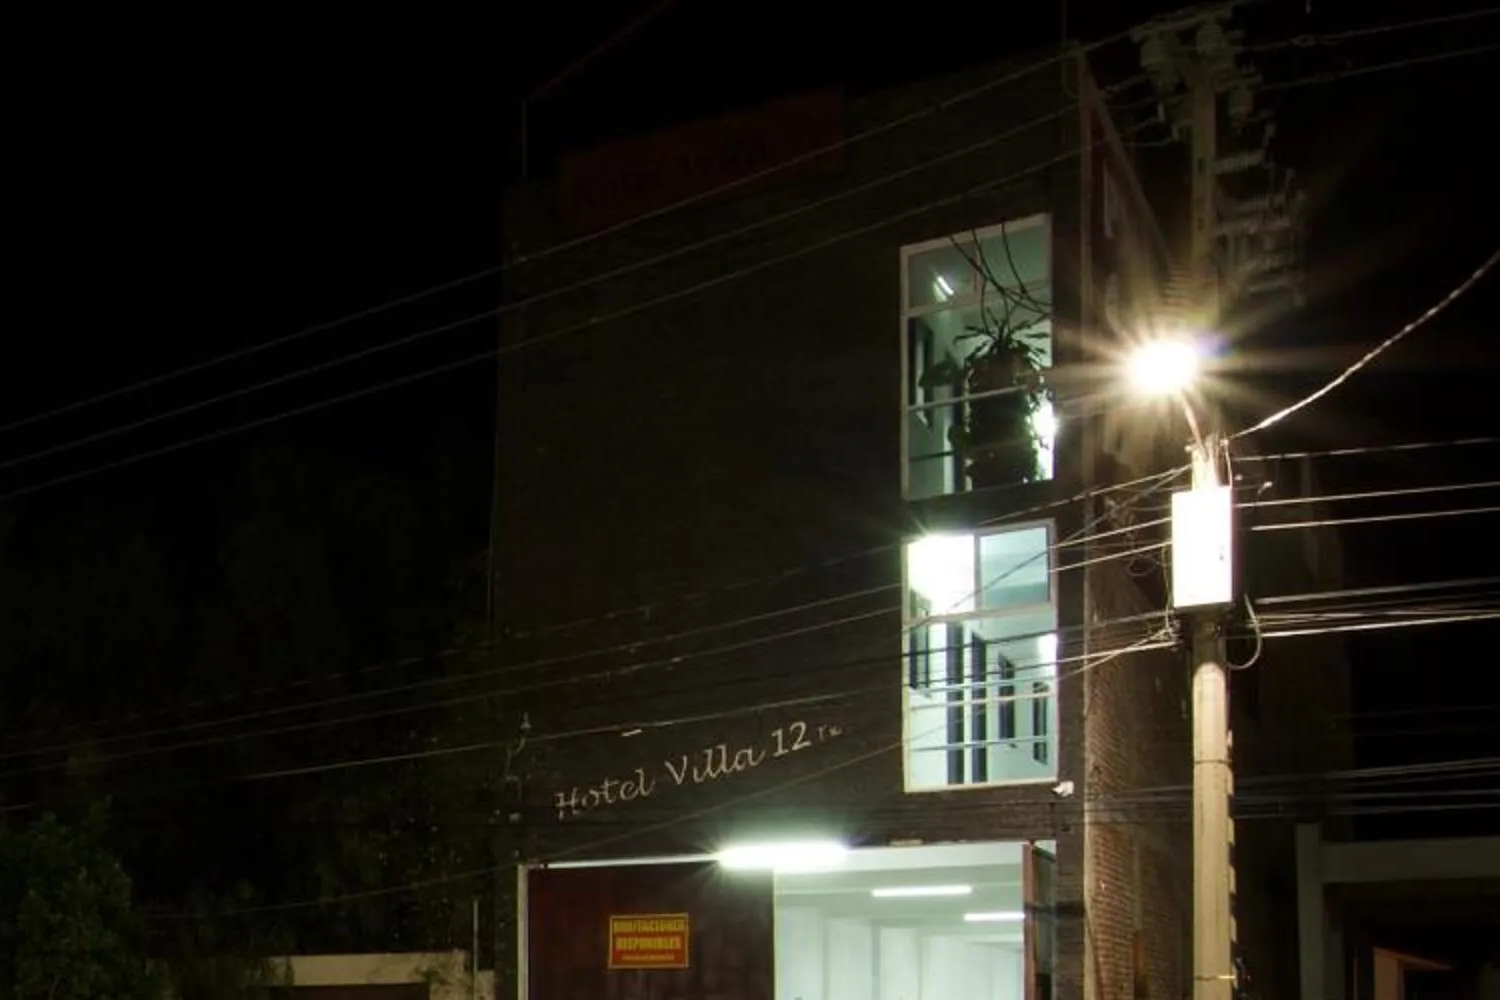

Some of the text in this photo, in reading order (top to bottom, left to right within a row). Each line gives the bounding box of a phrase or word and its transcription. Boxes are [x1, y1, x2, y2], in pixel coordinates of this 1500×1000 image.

[555, 769, 656, 820] Hotel
[664, 744, 766, 785] Villa
[770, 721, 812, 757] 12
